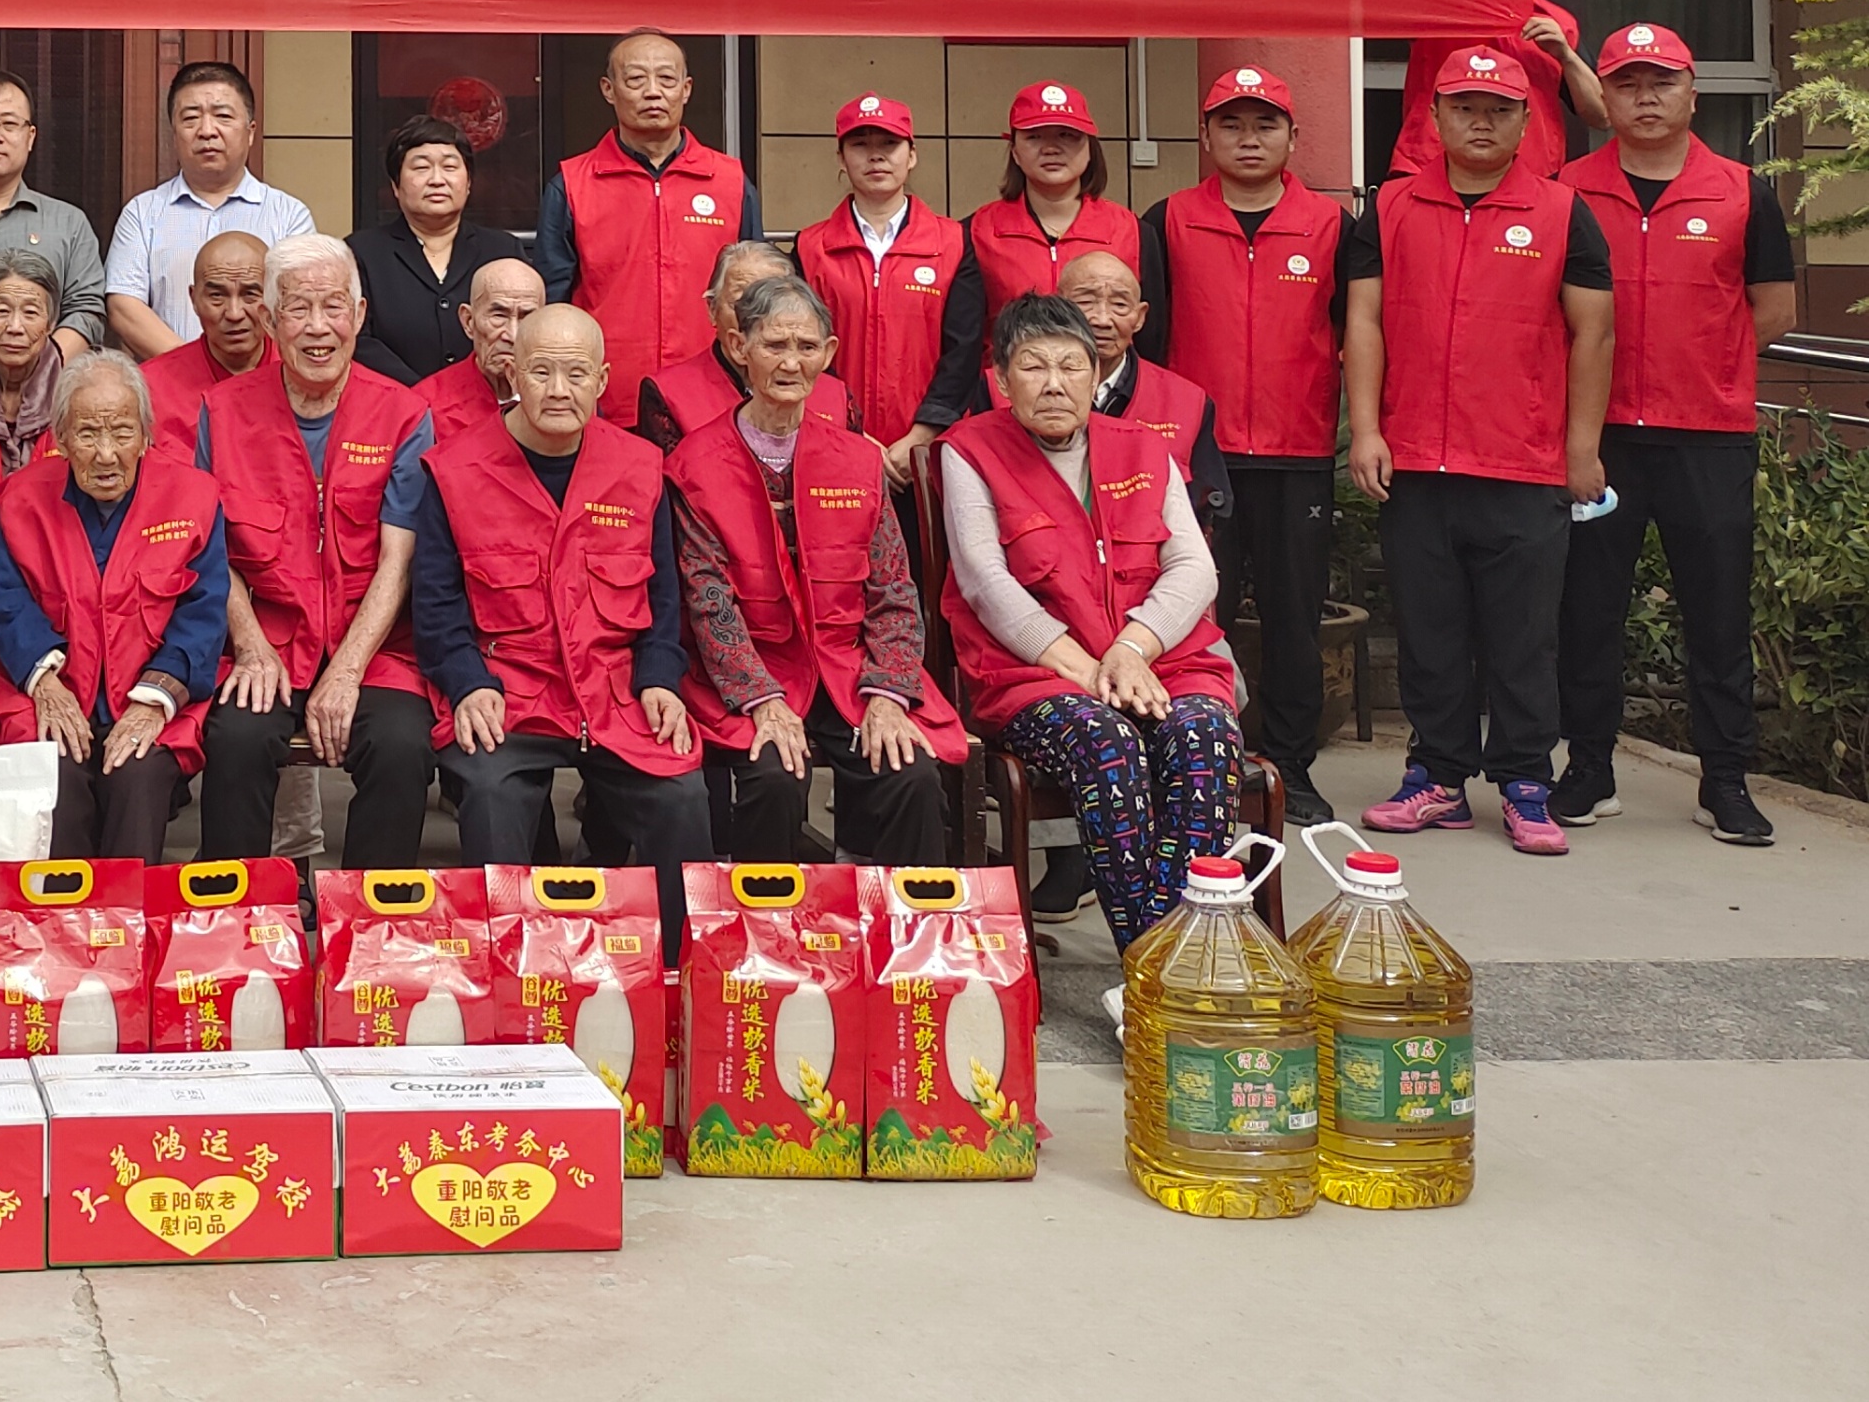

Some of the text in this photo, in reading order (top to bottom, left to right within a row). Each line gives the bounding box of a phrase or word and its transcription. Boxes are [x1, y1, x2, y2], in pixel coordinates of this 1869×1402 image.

[740, 978, 770, 1103] 优选软香米
[911, 977, 940, 1105] 优选软香米
[149, 1190, 237, 1212] 重阳敬老
[436, 1178, 532, 1202] 重阳敬老
[160, 1214, 226, 1236] 慰问品
[449, 1205, 520, 1228] 慰问品
